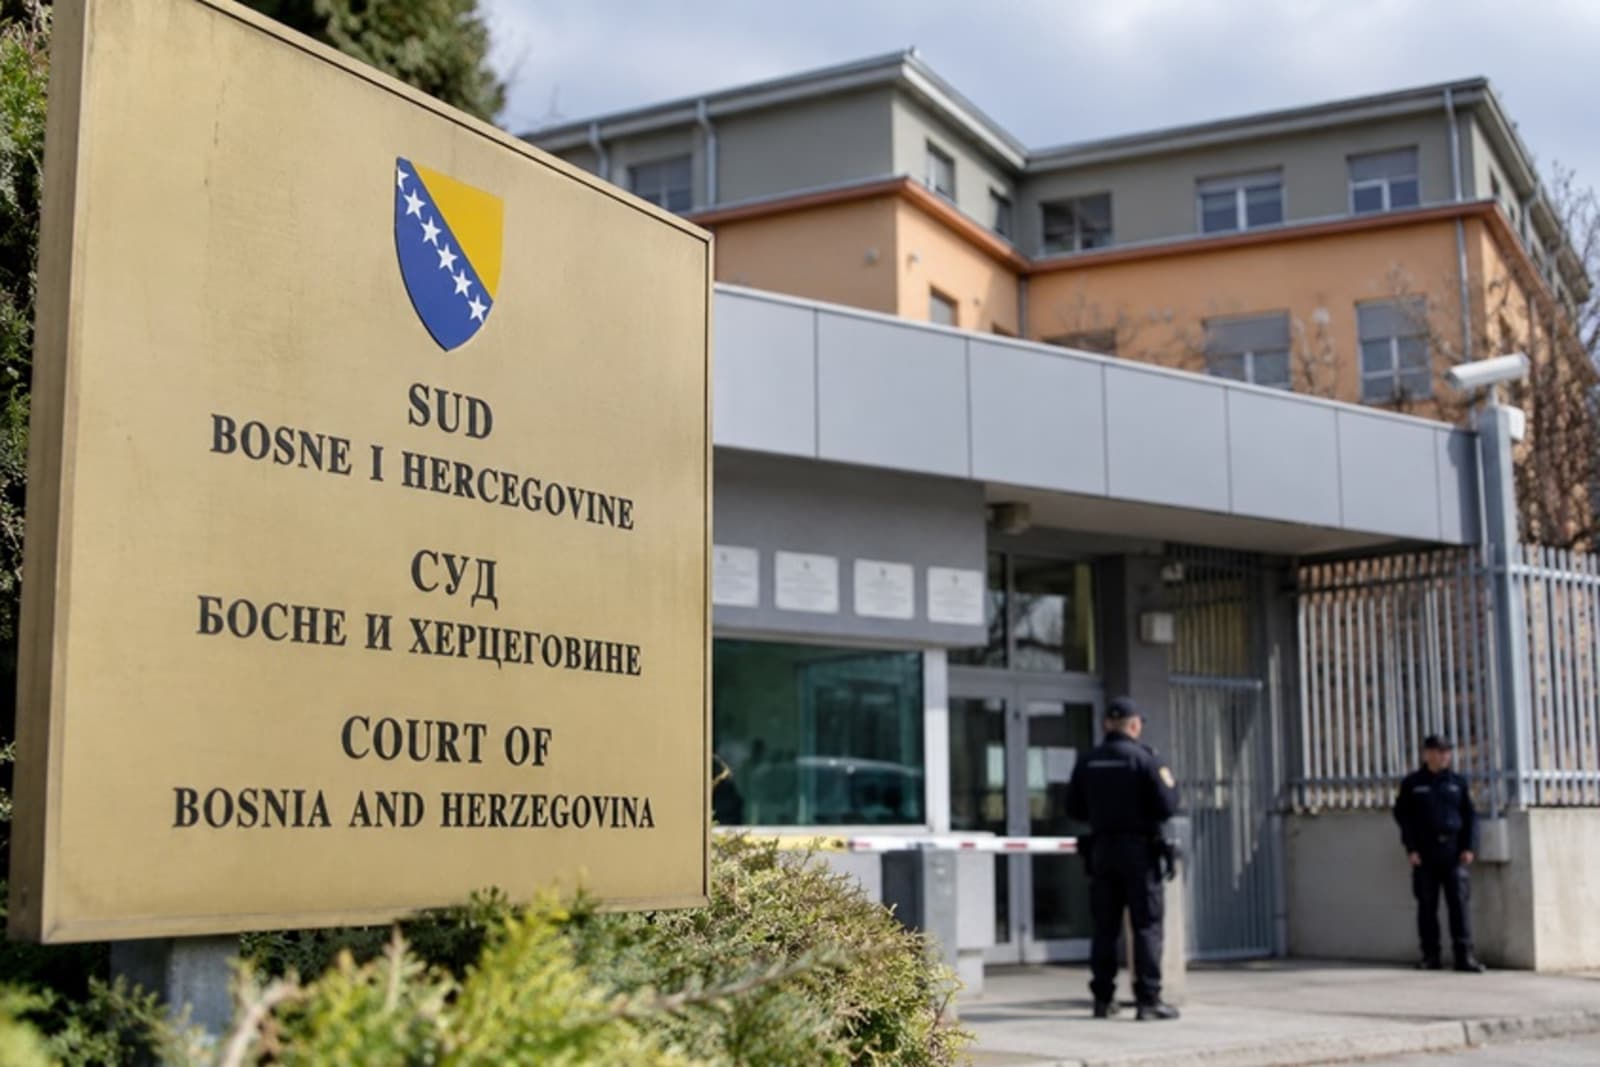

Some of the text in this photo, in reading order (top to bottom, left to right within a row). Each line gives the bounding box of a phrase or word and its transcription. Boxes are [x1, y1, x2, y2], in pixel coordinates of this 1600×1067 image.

[408, 382, 493, 440] SUD
[209, 413, 634, 531] BOSNE I HERCEGOVINE
[410, 549, 499, 611] СУД
[196, 594, 642, 677] БОСНЕ И ХЕРЦЕГОВИНЕ
[340, 715, 553, 767] COURT OF
[172, 787, 655, 829] BOSNIA AND HERZEGOVINA
